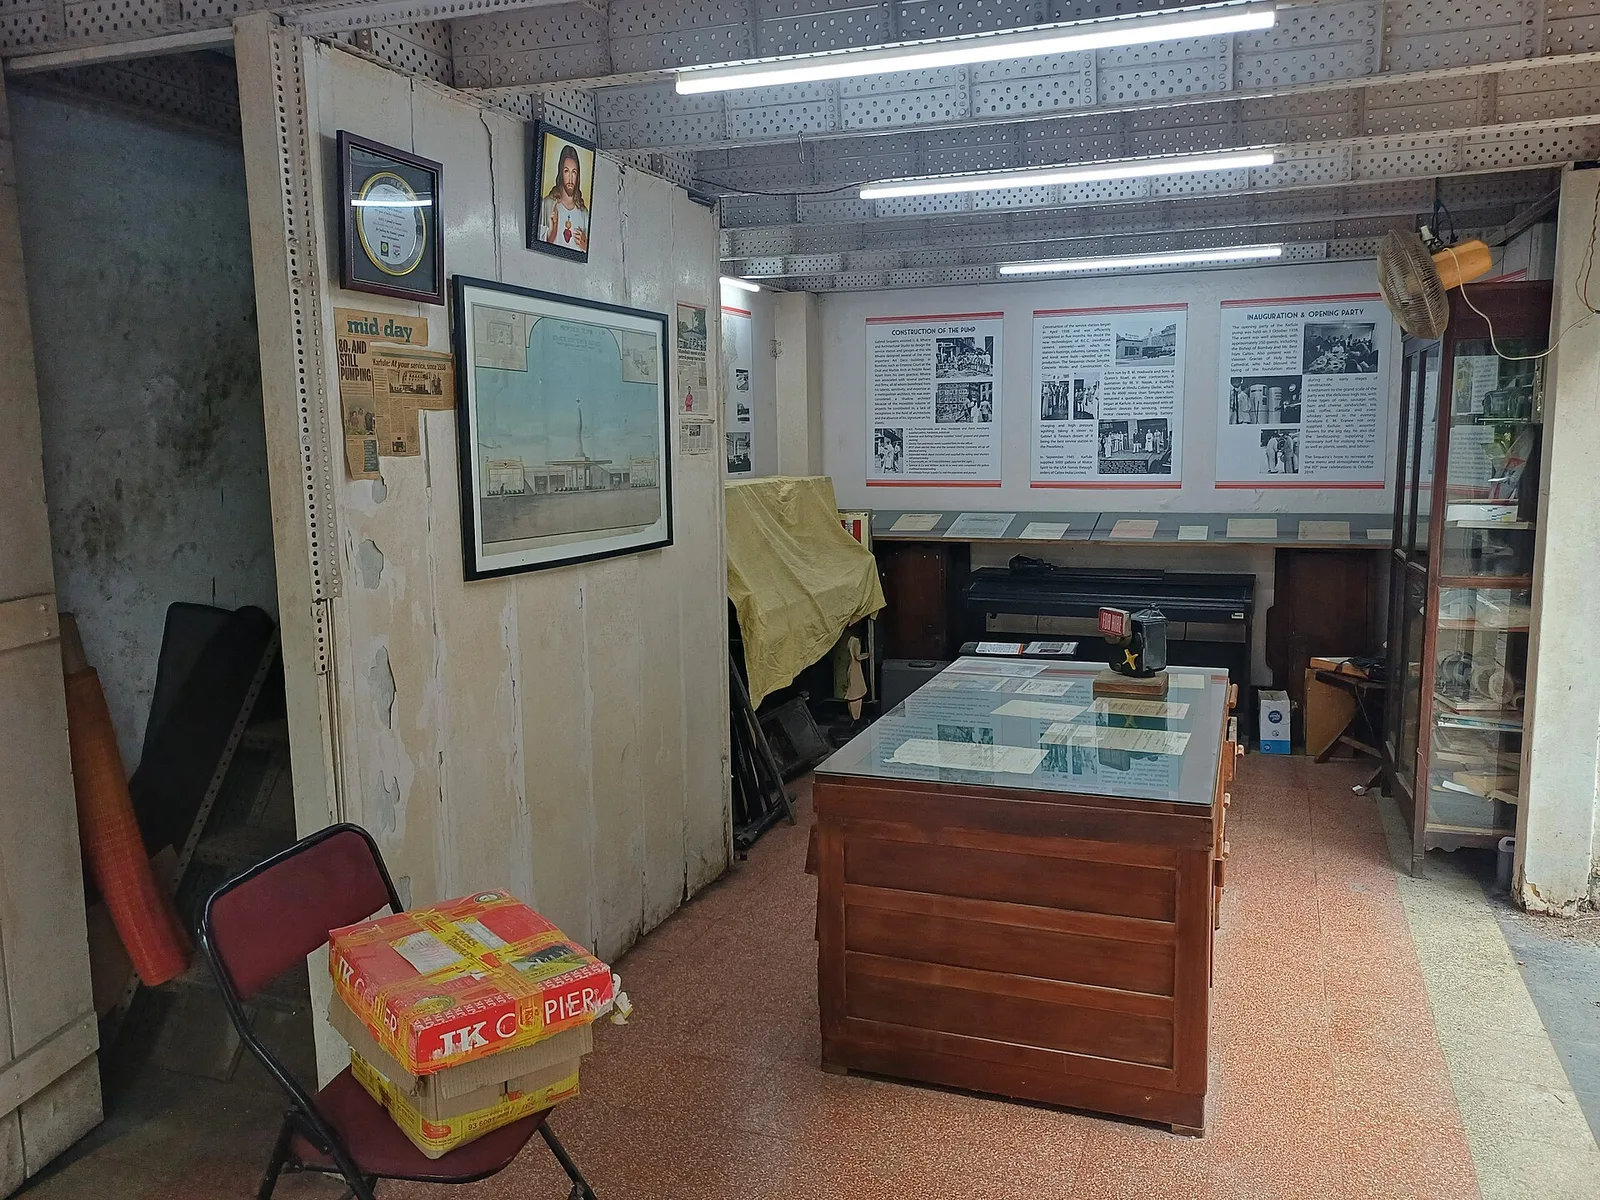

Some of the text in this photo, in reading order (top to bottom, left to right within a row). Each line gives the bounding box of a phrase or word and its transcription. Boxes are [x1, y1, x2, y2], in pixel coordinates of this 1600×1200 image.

[1246, 312, 1298, 320] INAUGURATION
[1308, 310, 1339, 318] OPENING
[338, 339, 366, 354] 80, AND
[340, 353, 358, 367] STILL
[341, 368, 371, 381] PUMPING
[1102, 612, 1122, 633] FOR HIRE
